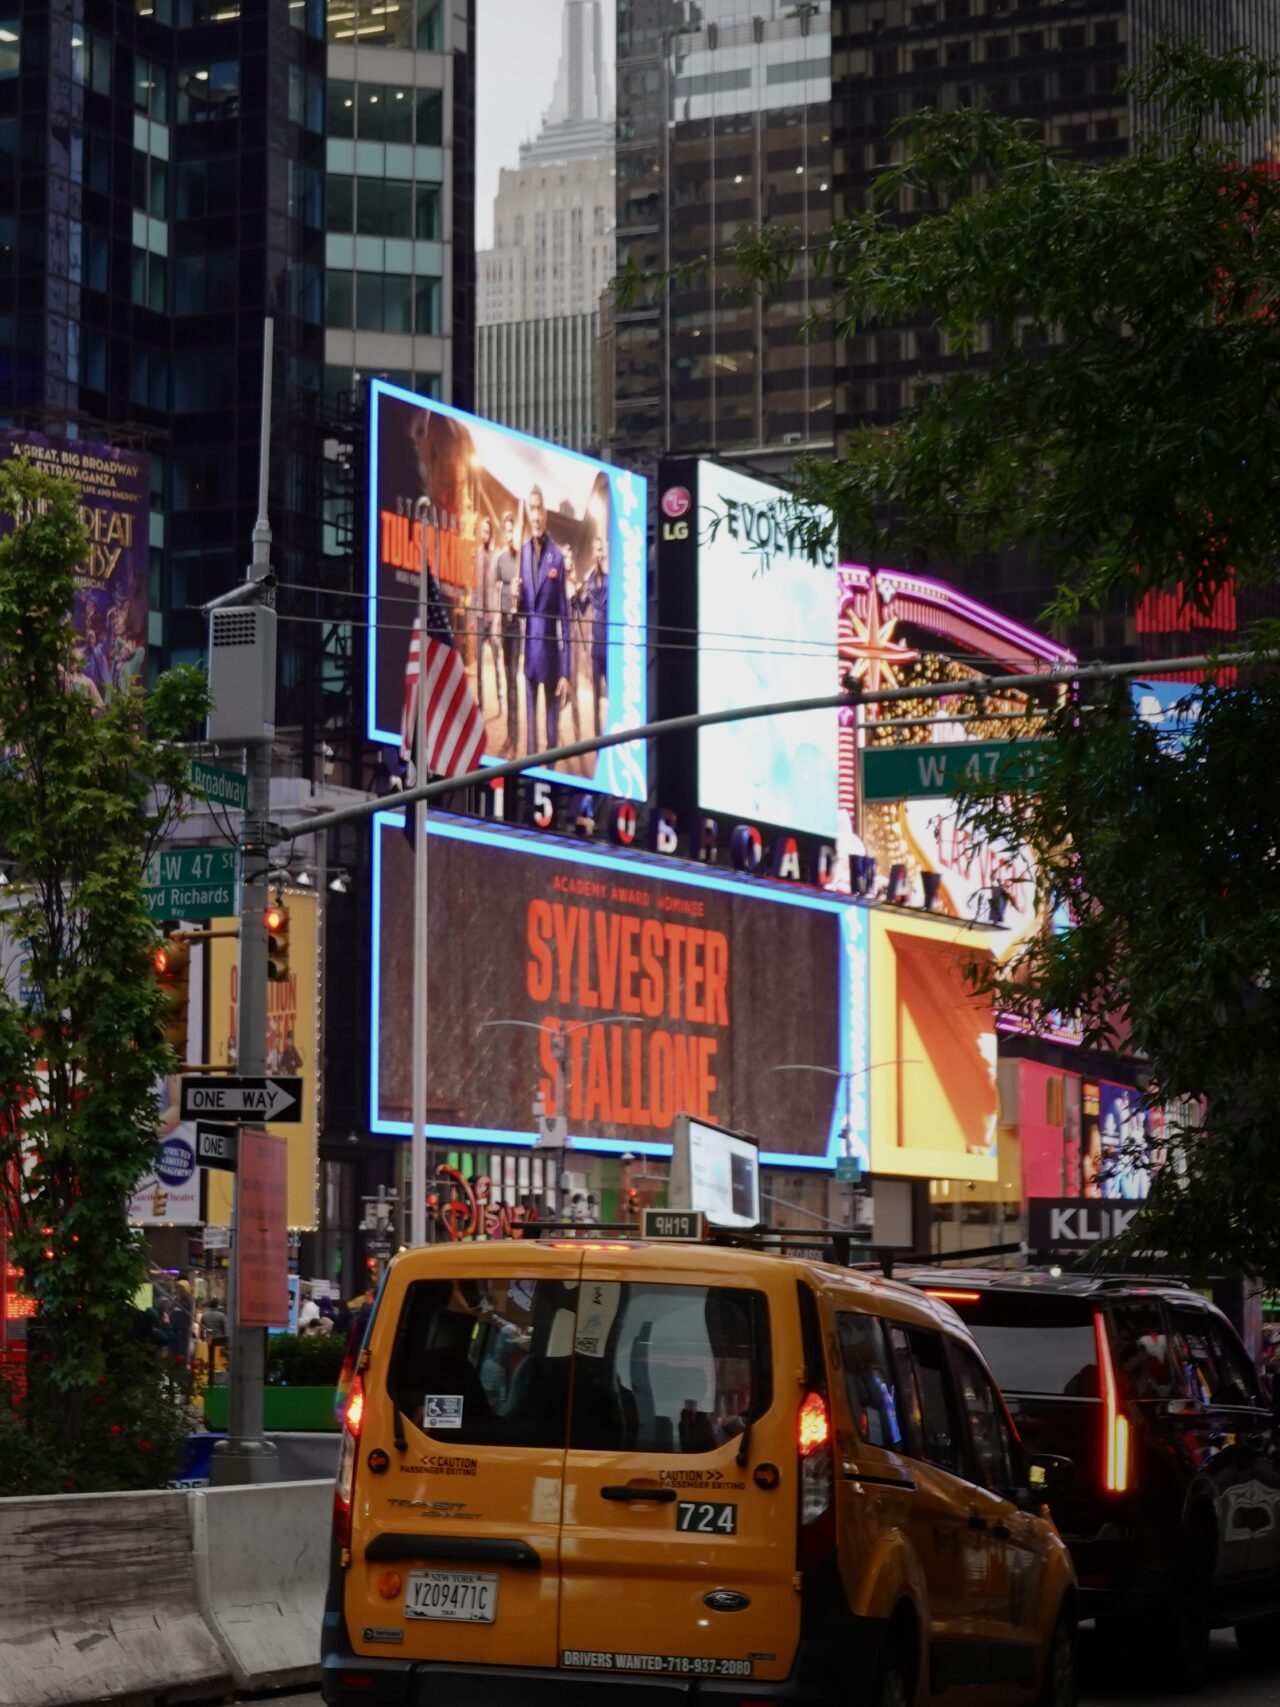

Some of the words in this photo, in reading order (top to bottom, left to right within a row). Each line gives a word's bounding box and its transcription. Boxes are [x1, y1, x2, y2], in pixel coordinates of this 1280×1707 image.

[35, 461, 117, 487] EXTRAVAGANZA
[61, 451, 80, 466] BIG
[82, 455, 139, 478] BROADWAY
[79, 505, 136, 548] REAT
[663, 520, 689, 541] LG
[917, 754, 947, 788] W
[966, 751, 1001, 785] 47
[194, 767, 247, 802] Broadway
[165, 855, 183, 881] W
[192, 853, 214, 880] 47
[221, 852, 234, 870] St
[171, 887, 230, 905] Richards
[552, 875, 607, 899] ACADEMY
[611, 885, 650, 907] AWARD
[655, 892, 705, 917] NOMINEE
[525, 899, 729, 1026] SYLVESTER
[538, 1015, 718, 1129] STALLONE
[193, 1091, 226, 1109] ONE
[242, 1091, 278, 1109] WAY
[203, 1136, 225, 1157] ONE
[400, 1465, 446, 1476] PASSENGER
[447, 1468, 477, 1477] EXITING
[437, 1457, 478, 1469] CAUTION
[659, 1470, 704, 1482] CAUTION
[659, 1481, 710, 1490] PASSENGER
[711, 1482, 746, 1490] EXITING
[678, 1502, 735, 1533] 724
[431, 1573, 451, 1582] NEW
[453, 1574, 476, 1584] YORK
[415, 1582, 488, 1610] Y209471C
[563, 1650, 614, 1668] DRIVERS
[614, 1652, 752, 1676] WANTED-718-937-2080
